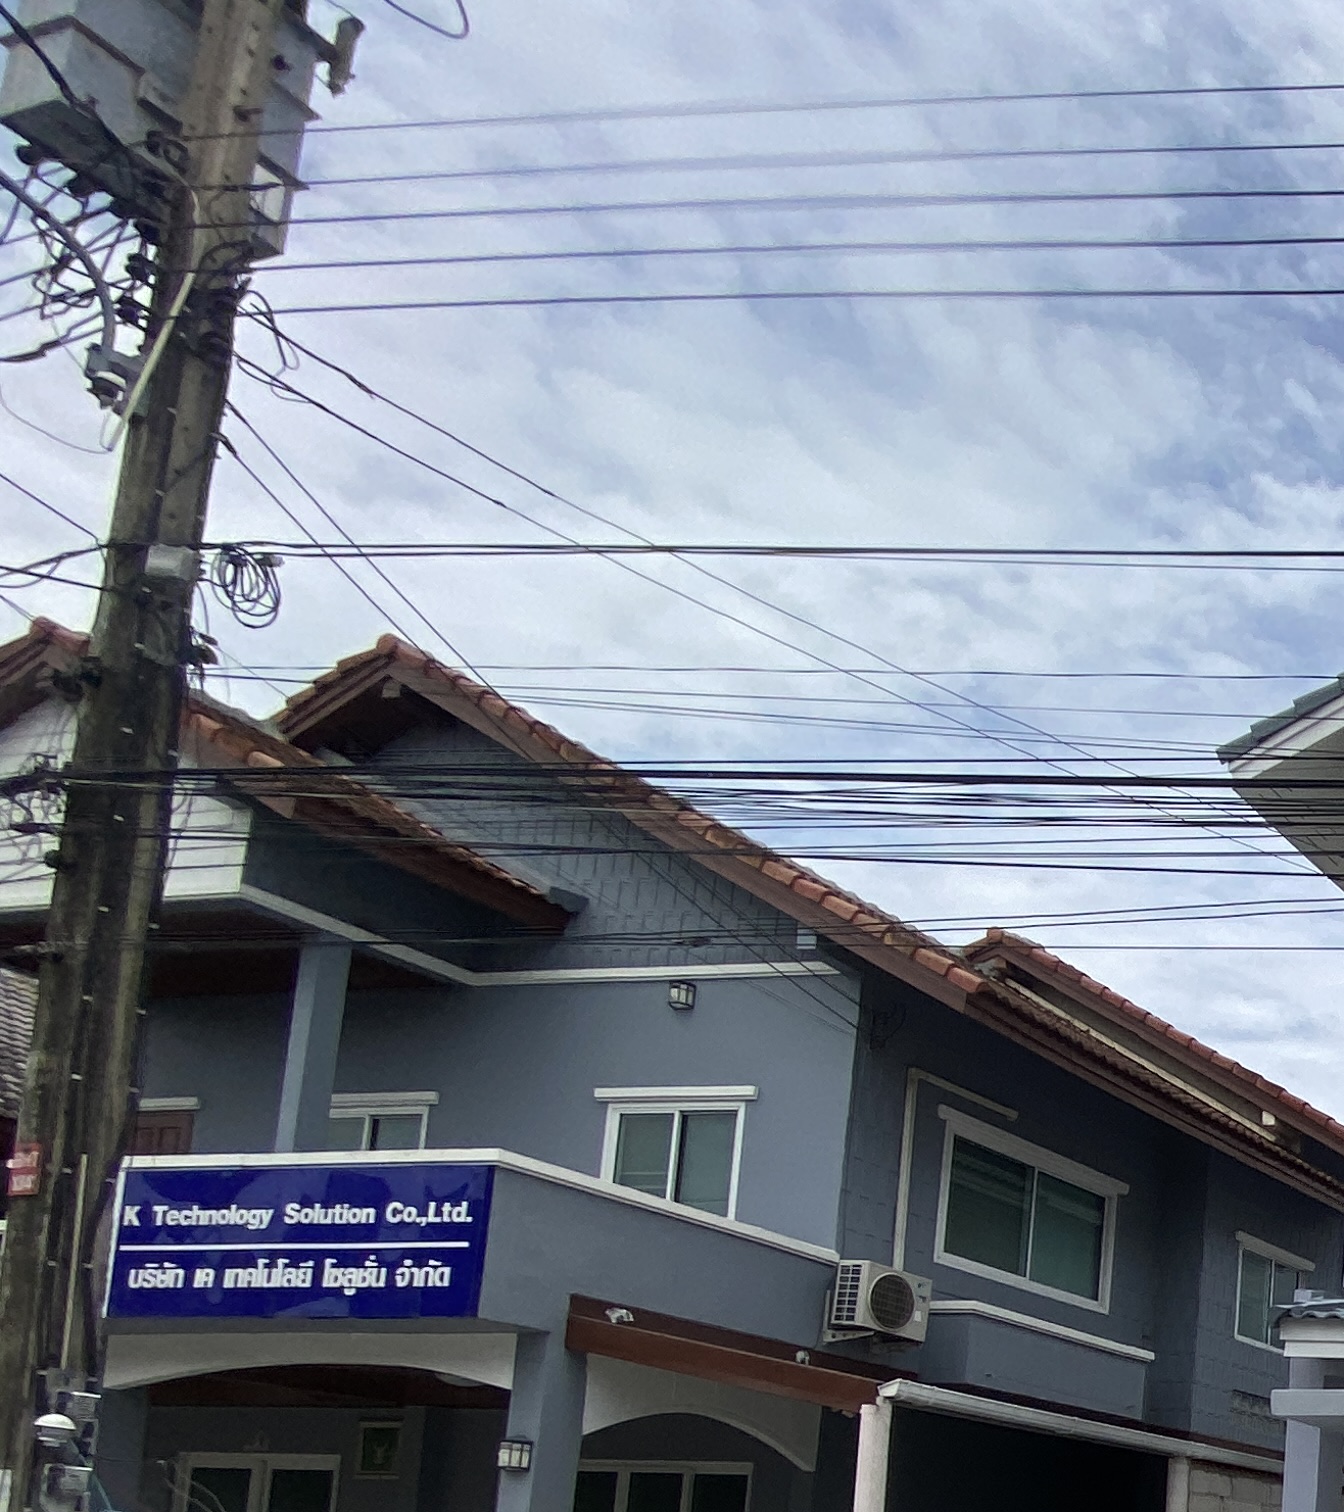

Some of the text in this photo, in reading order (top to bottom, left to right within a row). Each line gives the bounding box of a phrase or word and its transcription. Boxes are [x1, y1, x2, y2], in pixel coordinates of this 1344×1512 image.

[123, 1201, 473, 1230] K Technology Solution Co.,Ltd.
[127, 1254, 452, 1296] บริษัท เค เทคโนโลยี โซลูชั่น จำกัด
